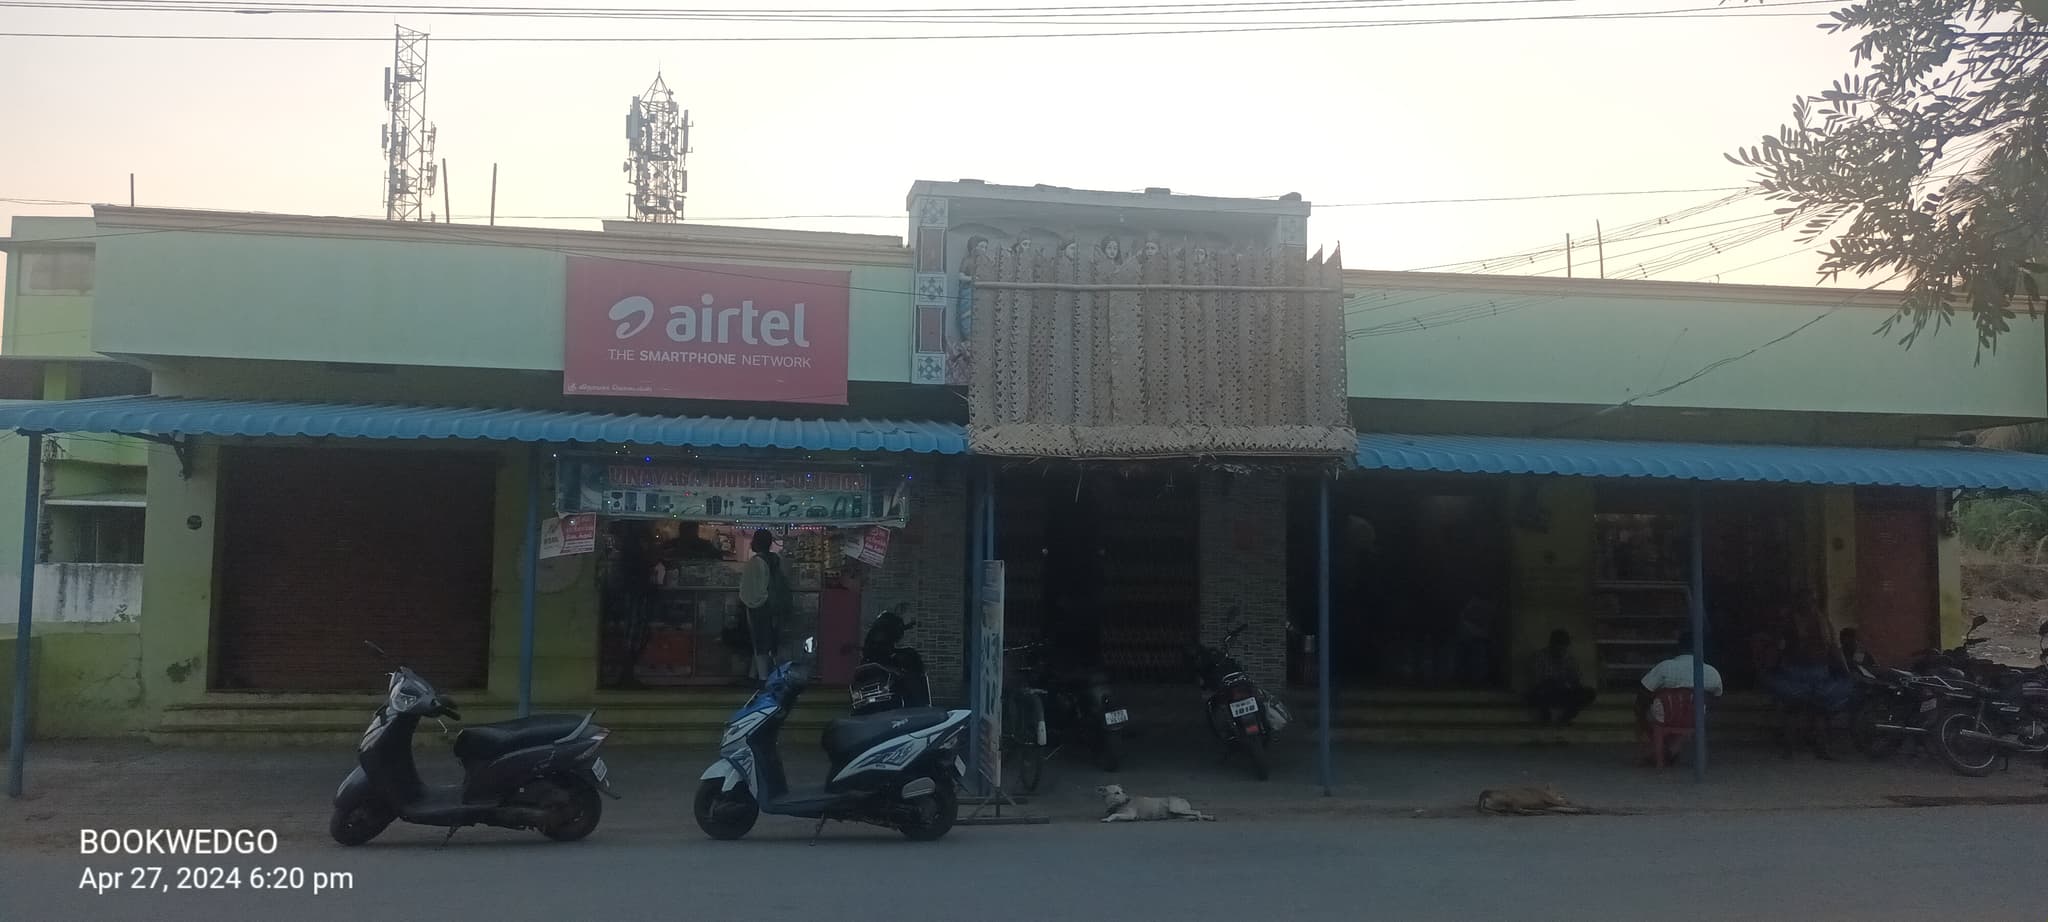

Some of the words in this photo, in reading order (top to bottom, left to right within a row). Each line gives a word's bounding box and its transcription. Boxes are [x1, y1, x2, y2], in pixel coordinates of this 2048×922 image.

[666, 293, 810, 348] airtel
[608, 348, 635, 361] THE
[639, 351, 737, 365] SMARTPHONE
[742, 355, 811, 368] NETWORK
